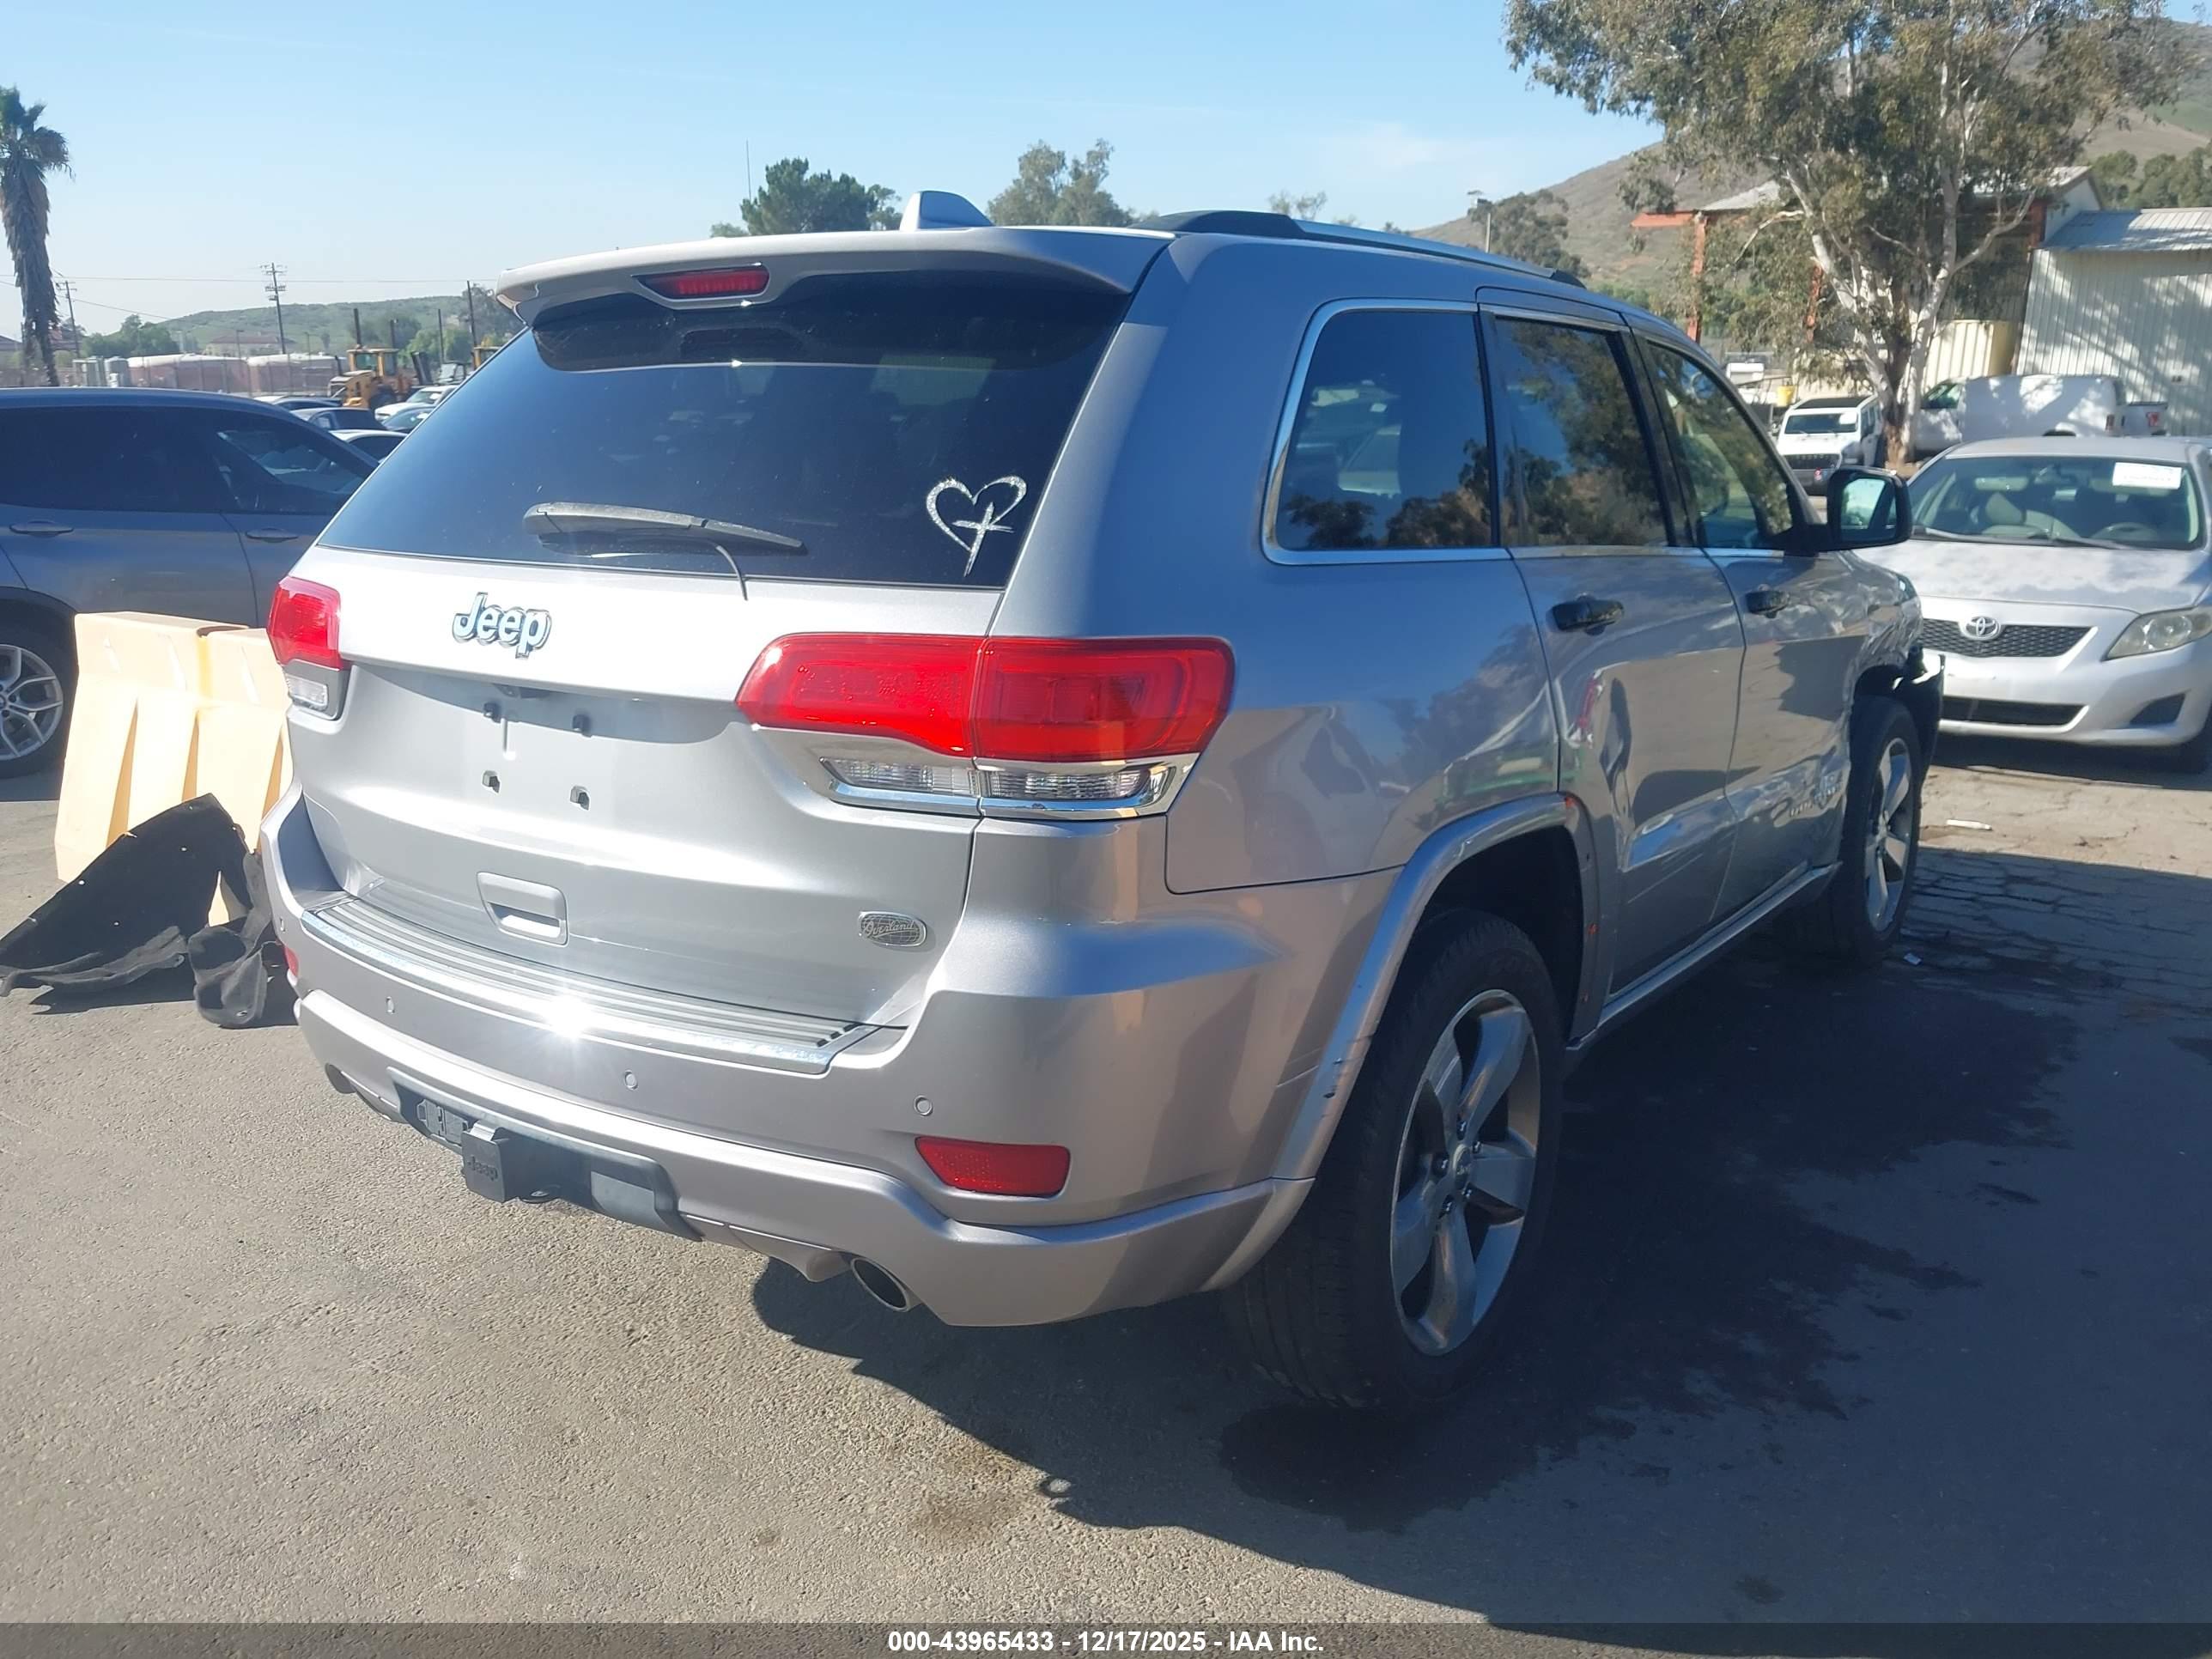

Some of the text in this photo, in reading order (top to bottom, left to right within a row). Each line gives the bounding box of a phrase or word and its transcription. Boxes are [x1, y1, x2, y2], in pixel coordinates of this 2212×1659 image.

[453, 592, 552, 659] Jeep
[863, 919, 915, 938] Overland
[466, 1155, 498, 1182] Jeep
